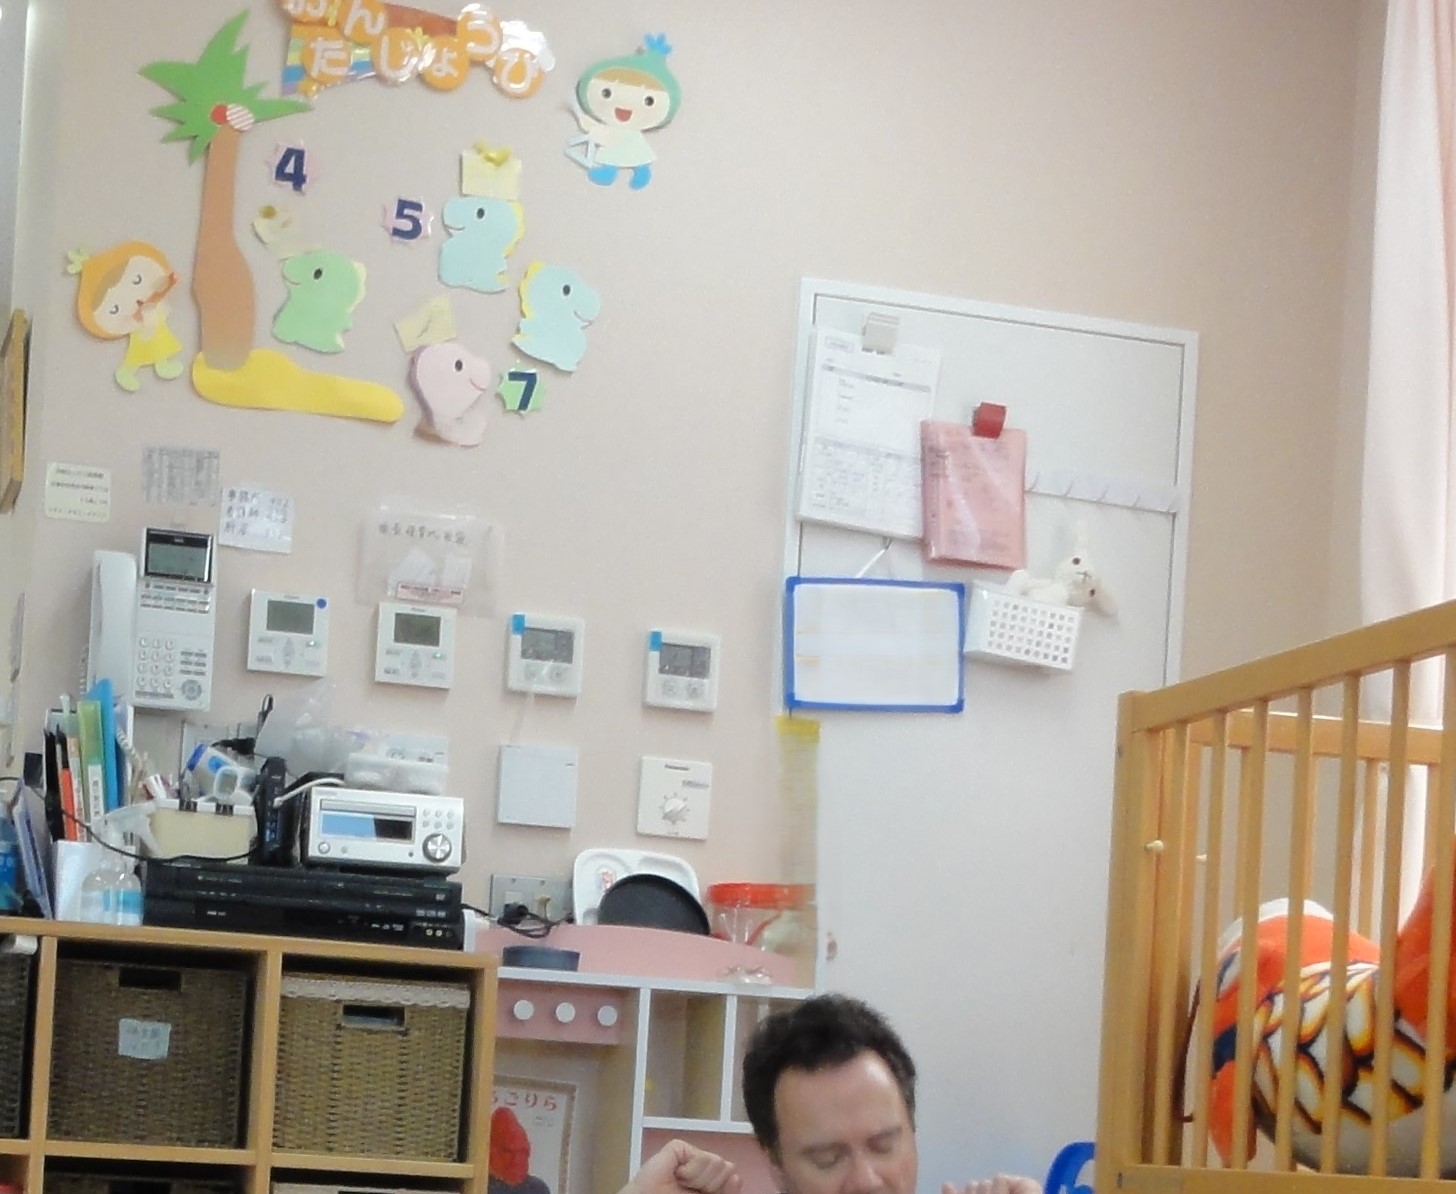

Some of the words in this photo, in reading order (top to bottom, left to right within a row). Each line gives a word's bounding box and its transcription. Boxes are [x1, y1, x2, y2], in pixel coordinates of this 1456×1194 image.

[275, 147, 307, 192] 4
[392, 198, 424, 240] 5
[508, 371, 538, 411] 7
